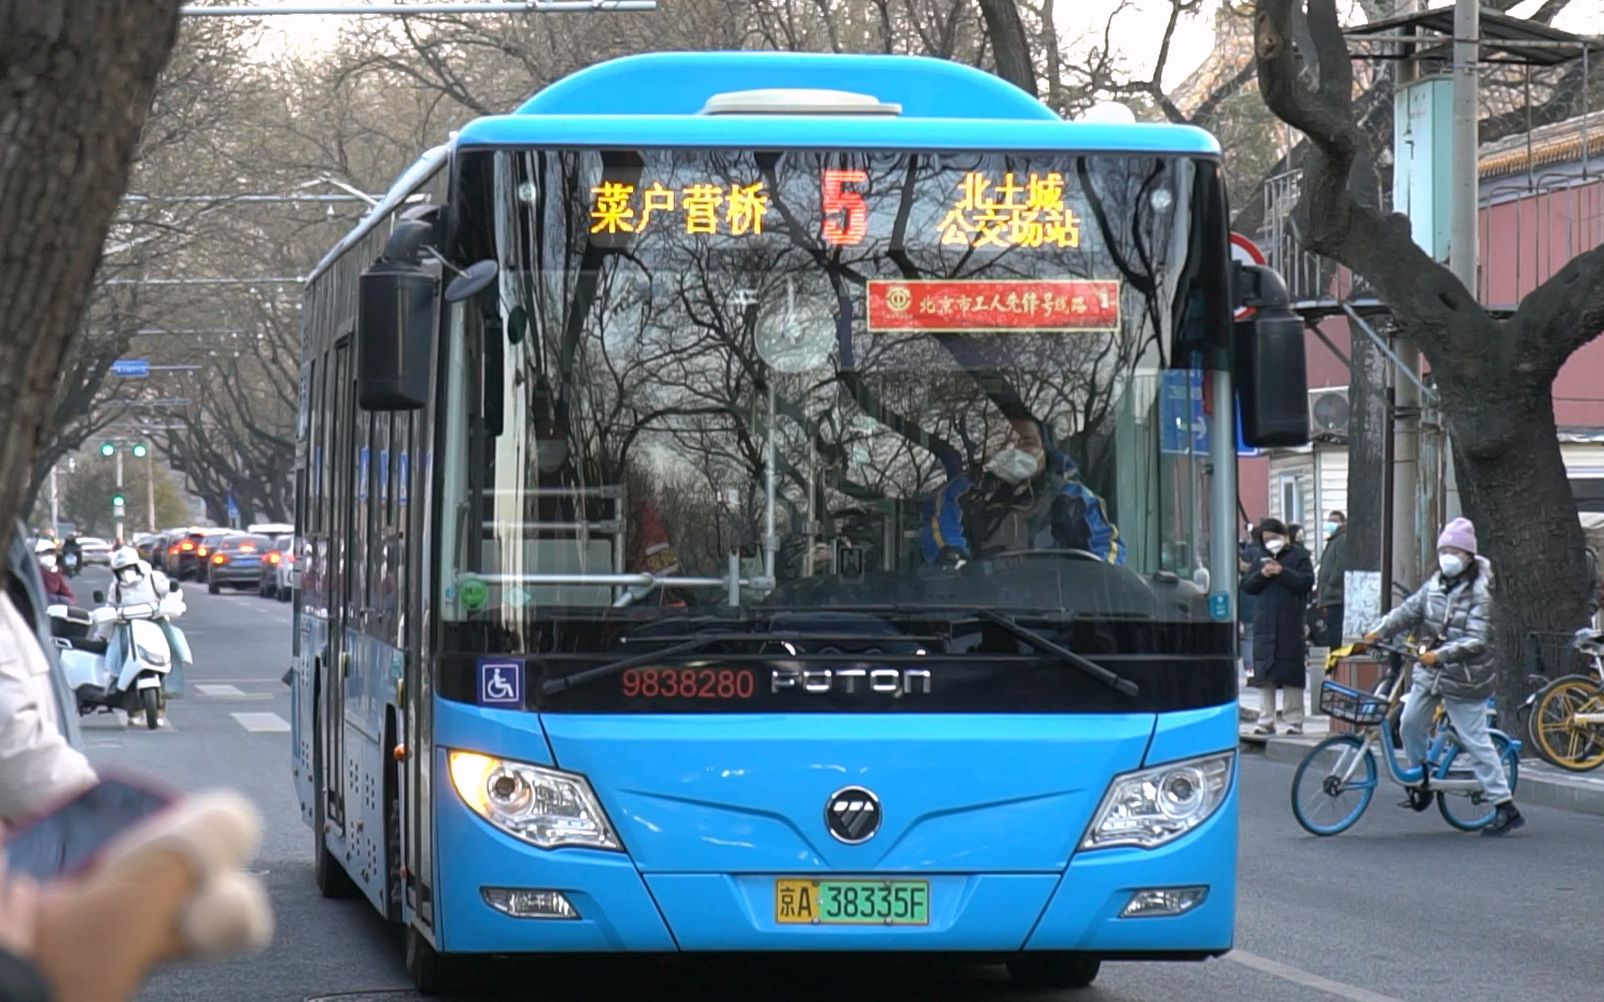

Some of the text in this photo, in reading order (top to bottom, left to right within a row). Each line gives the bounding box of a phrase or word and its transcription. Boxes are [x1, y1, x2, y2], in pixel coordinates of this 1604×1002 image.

[590, 181, 768, 236] 菜户营桥
[822, 169, 867, 246] 5
[956, 171, 1064, 211] 北土城
[937, 208, 1081, 249] 公交场站
[622, 669, 754, 698] 9838280
[780, 886, 925, 918] 京A 38335F
